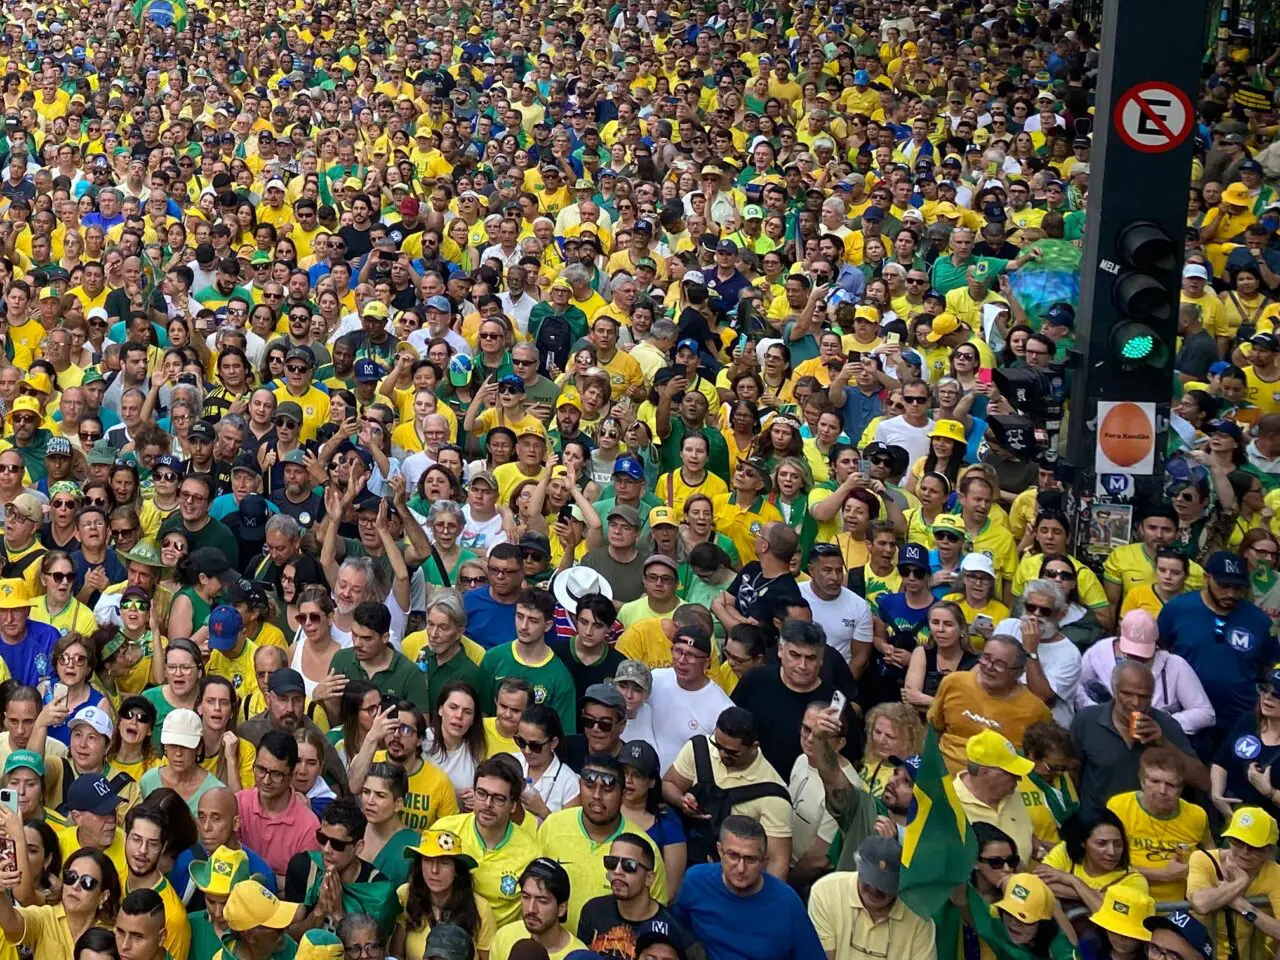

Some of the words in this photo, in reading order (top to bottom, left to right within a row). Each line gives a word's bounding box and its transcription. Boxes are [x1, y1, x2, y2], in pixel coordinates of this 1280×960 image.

[1137, 98, 1172, 137] E
[46, 444, 70, 453] JOHN
[47, 437, 69, 446] JOHN
[1110, 476, 1125, 490] M
[907, 547, 920, 559] M
[1232, 631, 1249, 648] M
[1238, 738, 1259, 757] M
[93, 778, 110, 796] M
[652, 921, 669, 936] M
